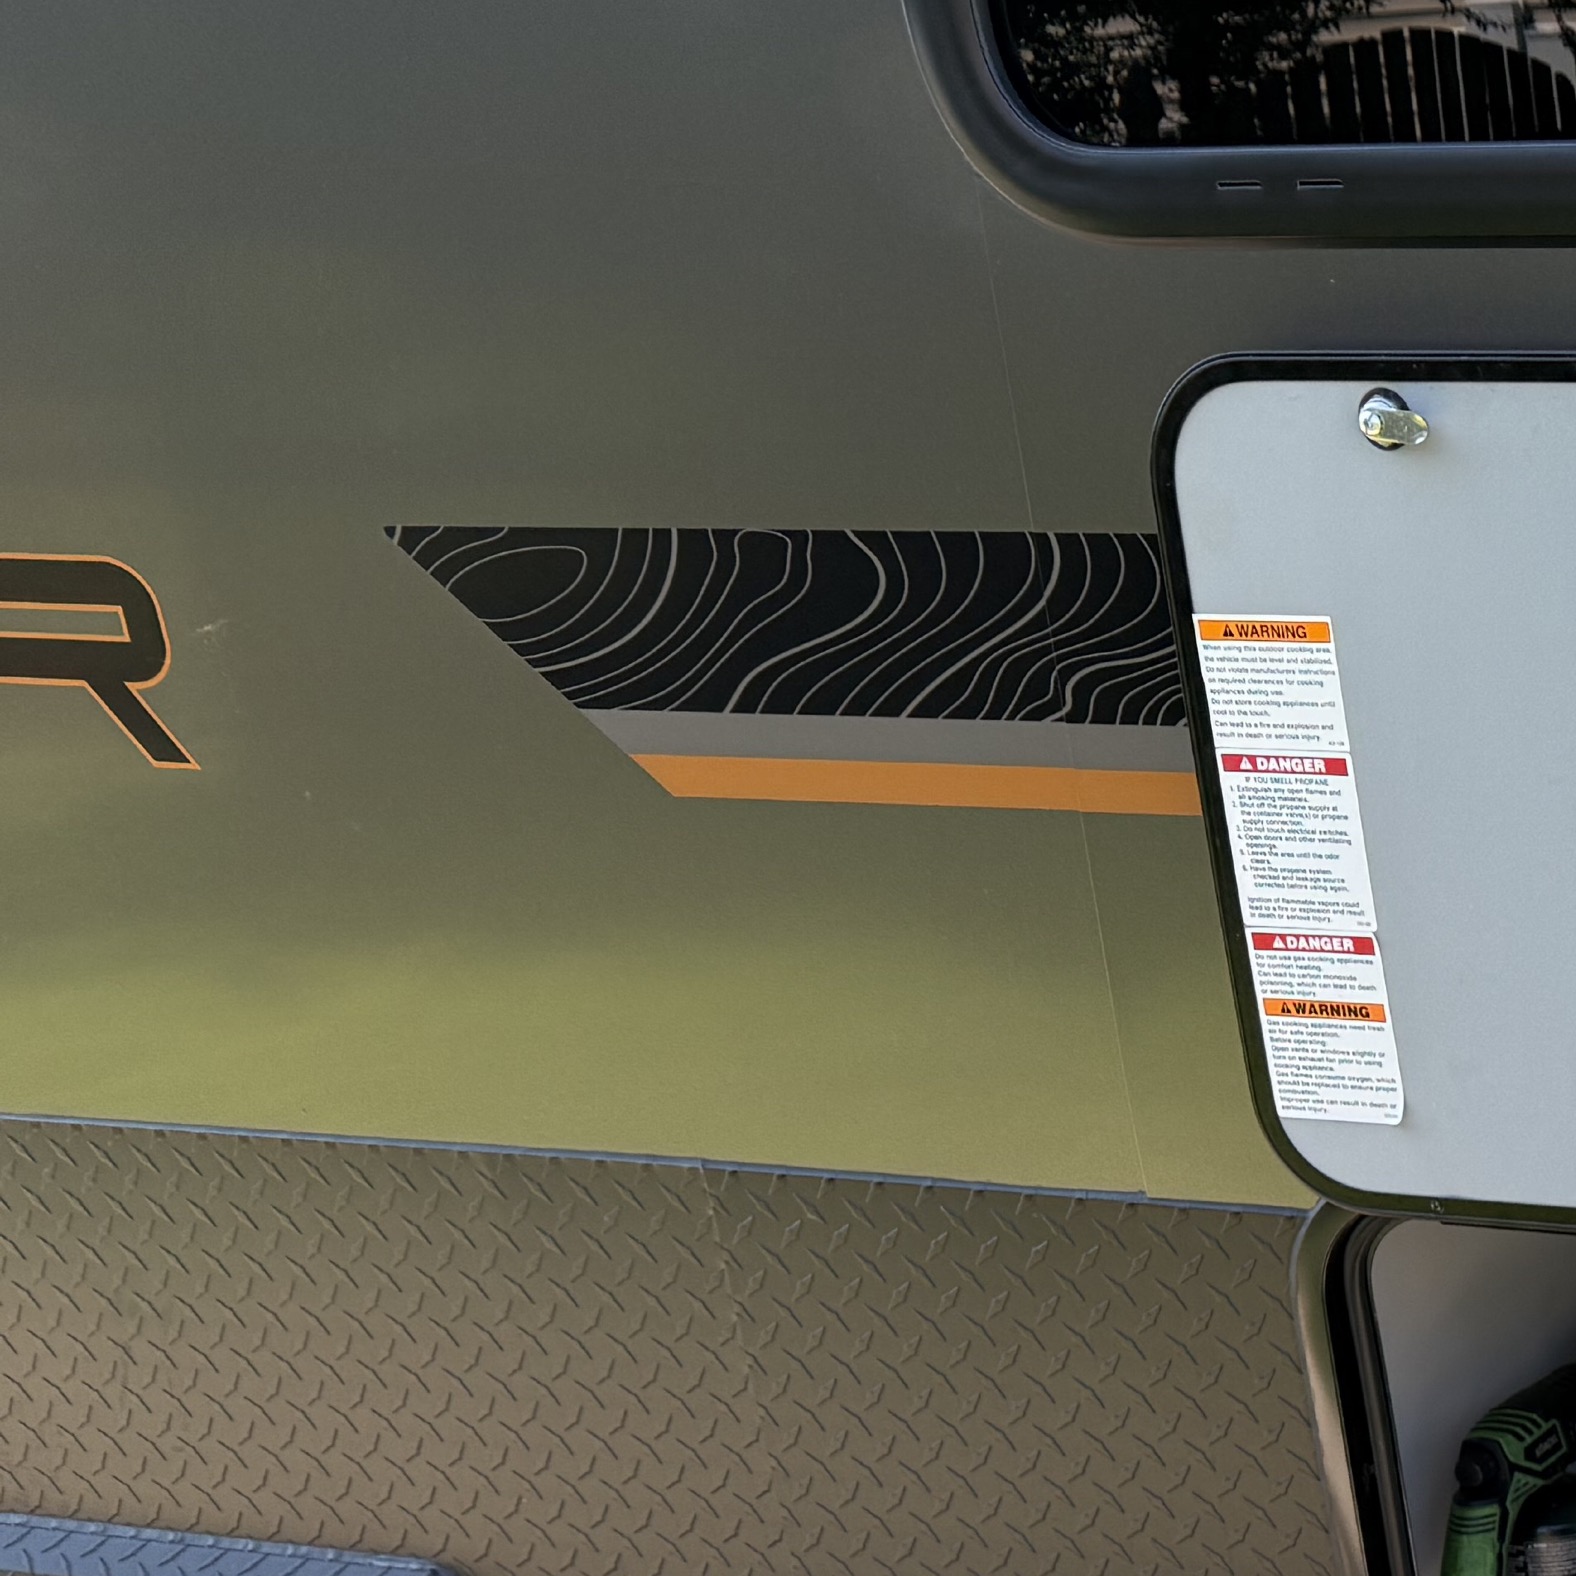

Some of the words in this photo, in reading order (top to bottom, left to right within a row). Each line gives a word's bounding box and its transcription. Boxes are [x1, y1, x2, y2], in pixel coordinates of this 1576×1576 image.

[1235, 624, 1307, 638] WARNING
[0, 553, 201, 769] R
[1255, 756, 1326, 772] DANGER
[1285, 935, 1354, 951] DANGER
[1292, 1002, 1369, 1018] WARNING
